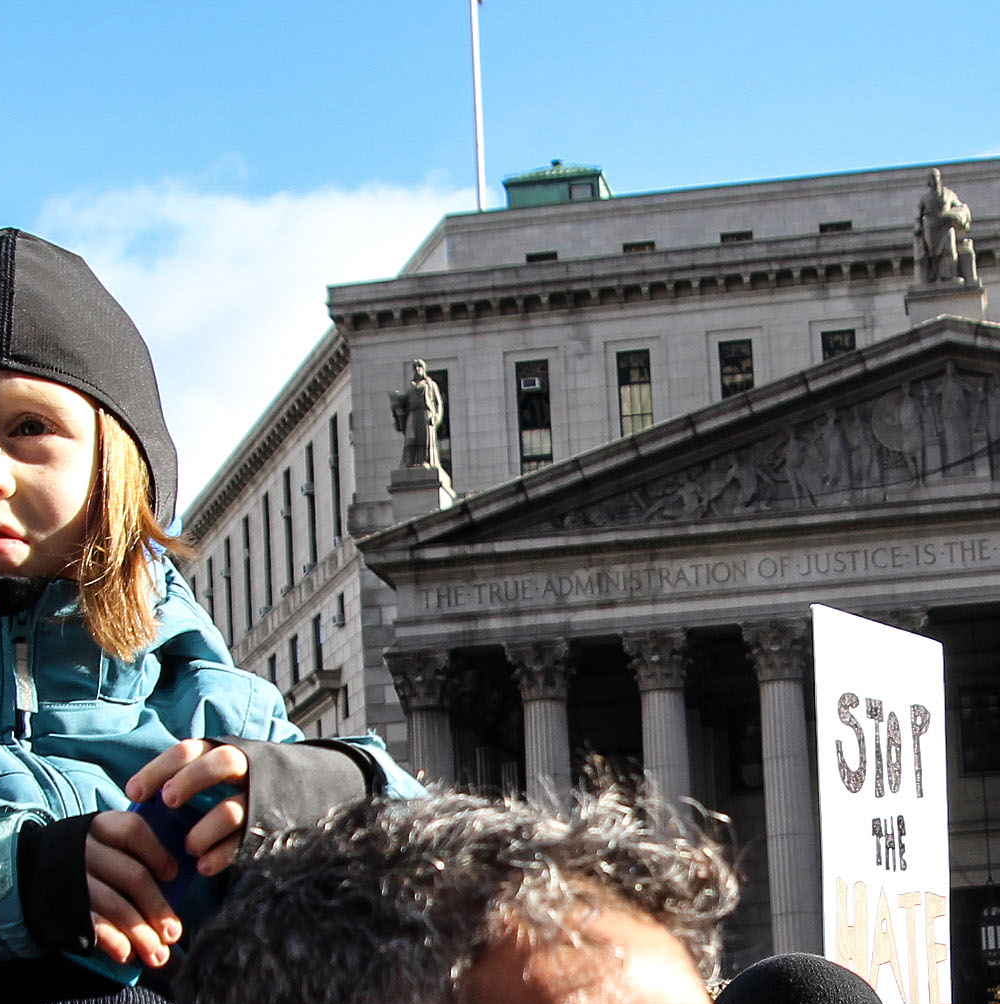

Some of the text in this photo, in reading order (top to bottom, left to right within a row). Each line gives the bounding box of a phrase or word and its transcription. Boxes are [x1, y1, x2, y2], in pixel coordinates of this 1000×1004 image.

[419, 537, 992, 610] THE TRUE ADMINISTRATION OF JUSTICE IS THE
[835, 691, 931, 799] STOP
[871, 814, 907, 873] THE
